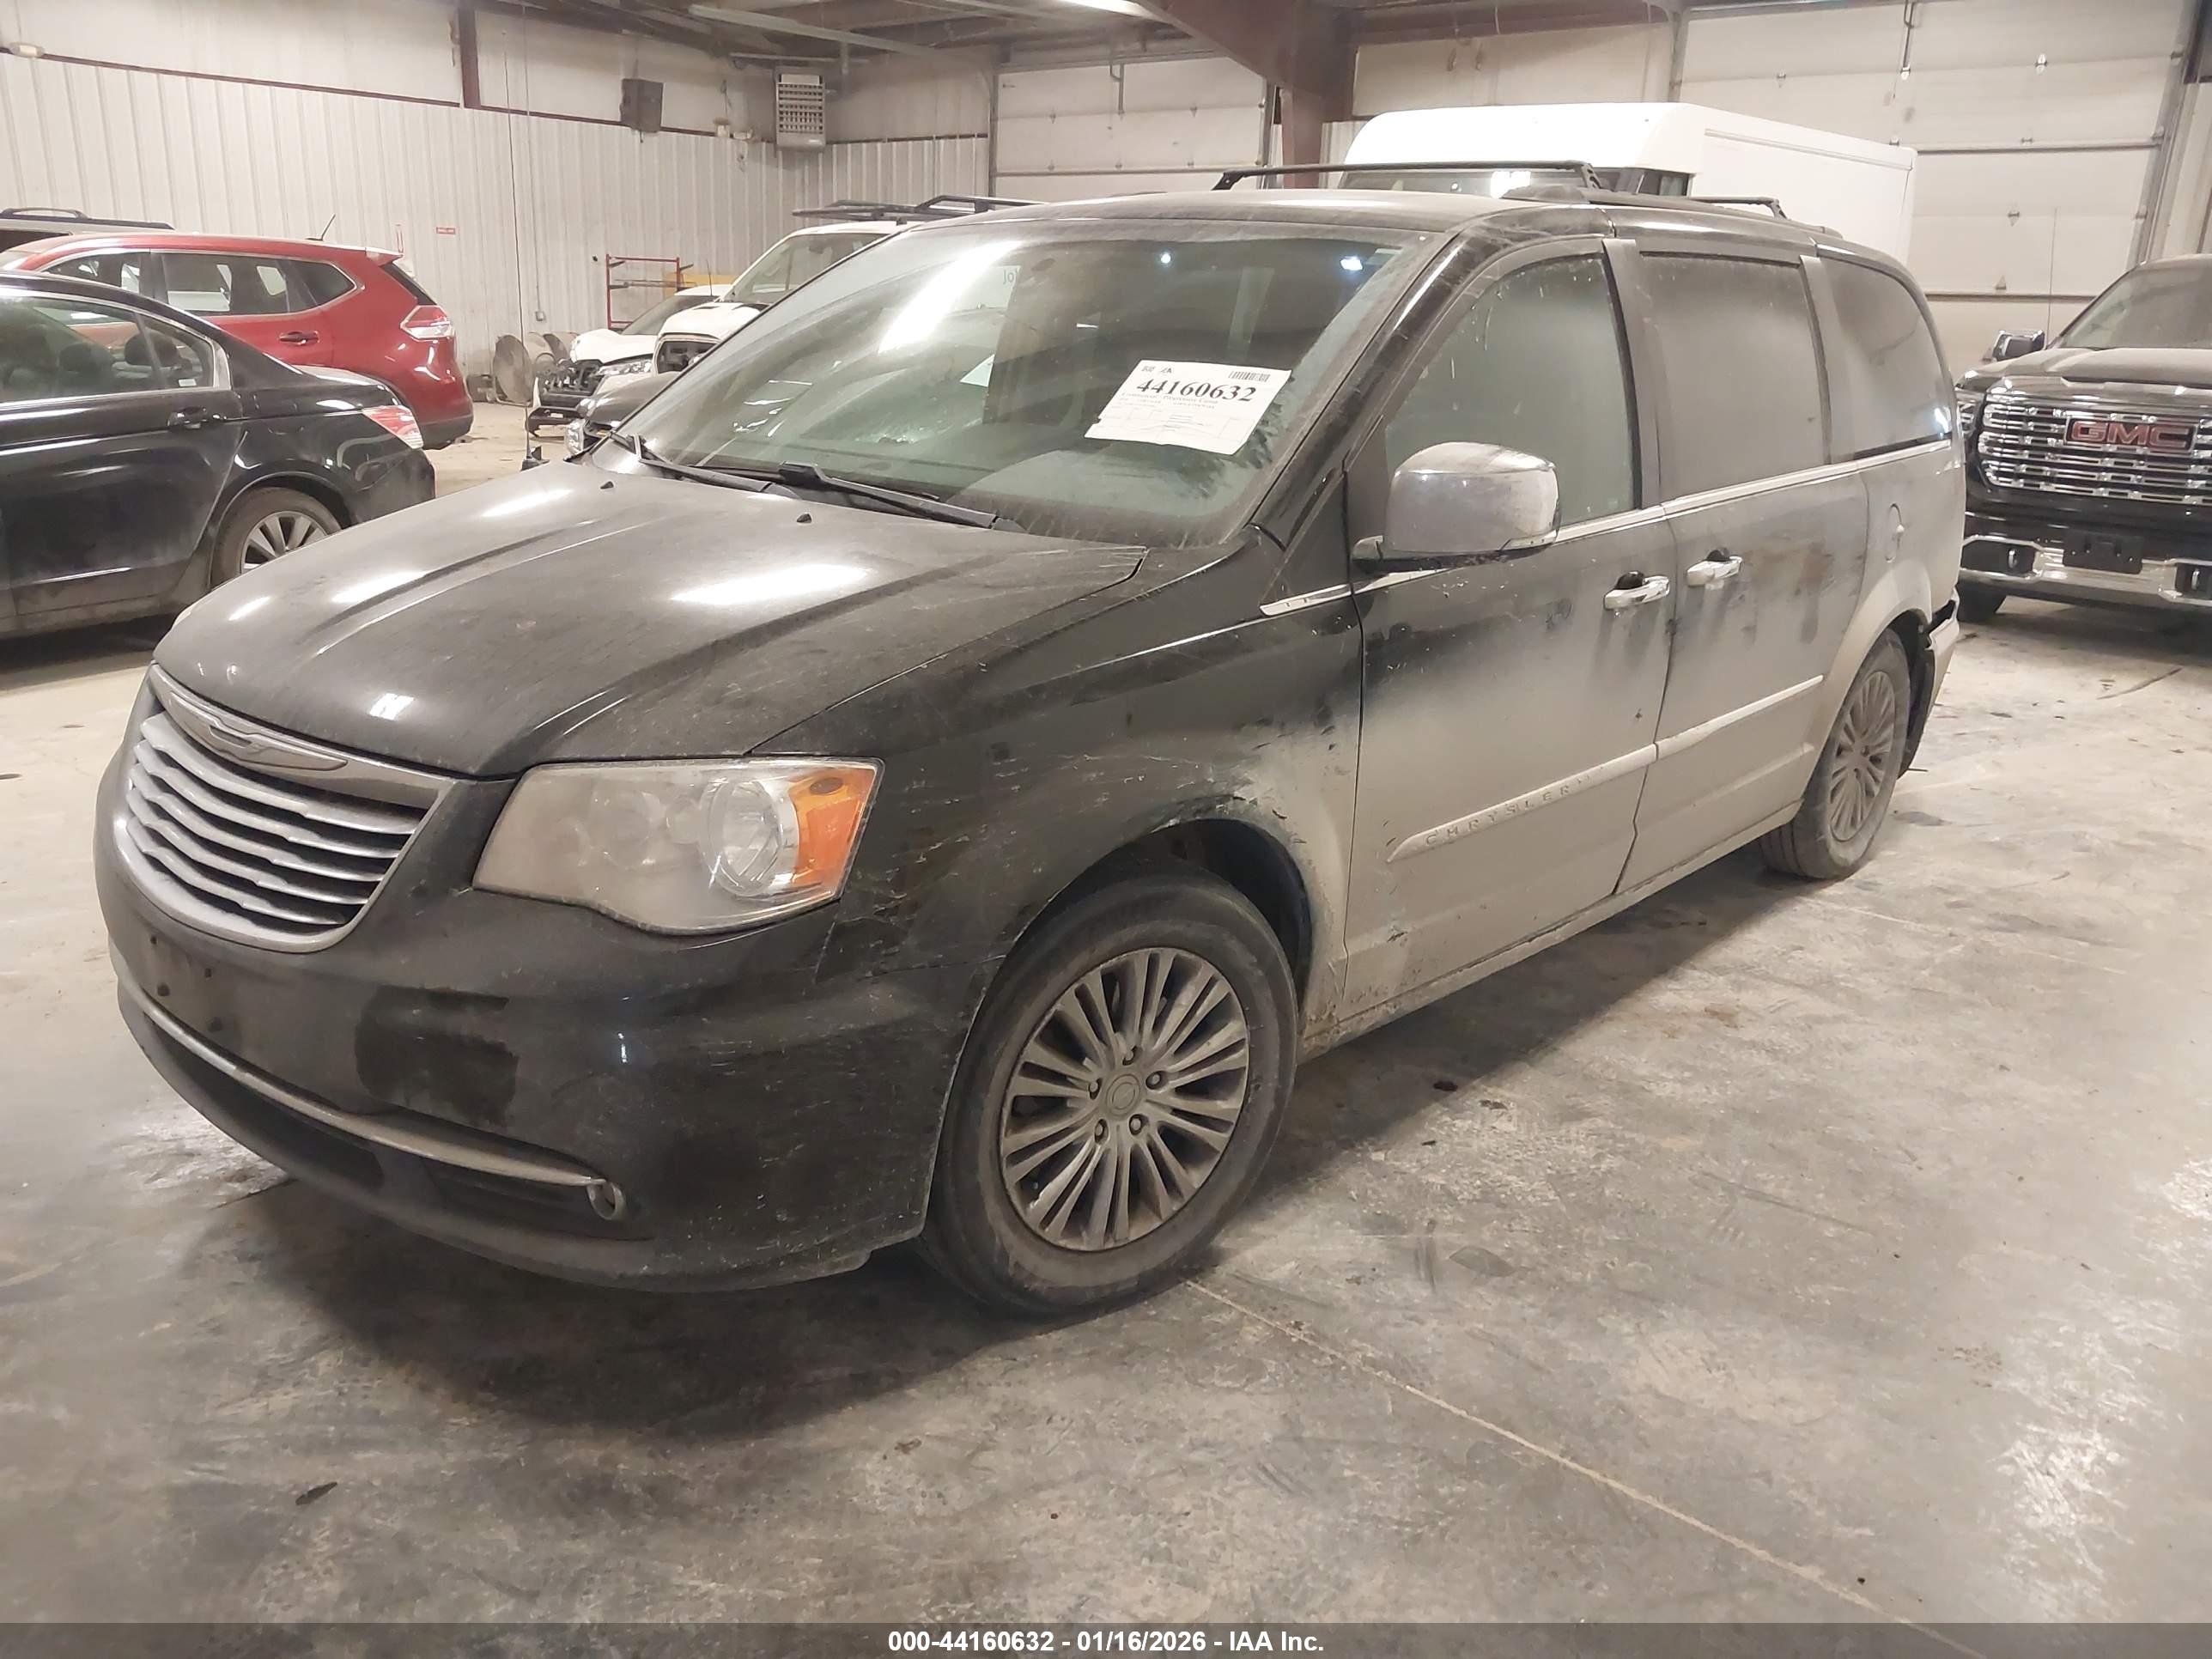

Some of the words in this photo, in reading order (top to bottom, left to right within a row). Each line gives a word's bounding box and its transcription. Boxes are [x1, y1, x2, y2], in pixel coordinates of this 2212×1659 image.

[1136, 379, 1256, 402] 44160632
[2071, 420, 2189, 448] GMC
[1425, 785, 1571, 847] CHRYSLER
